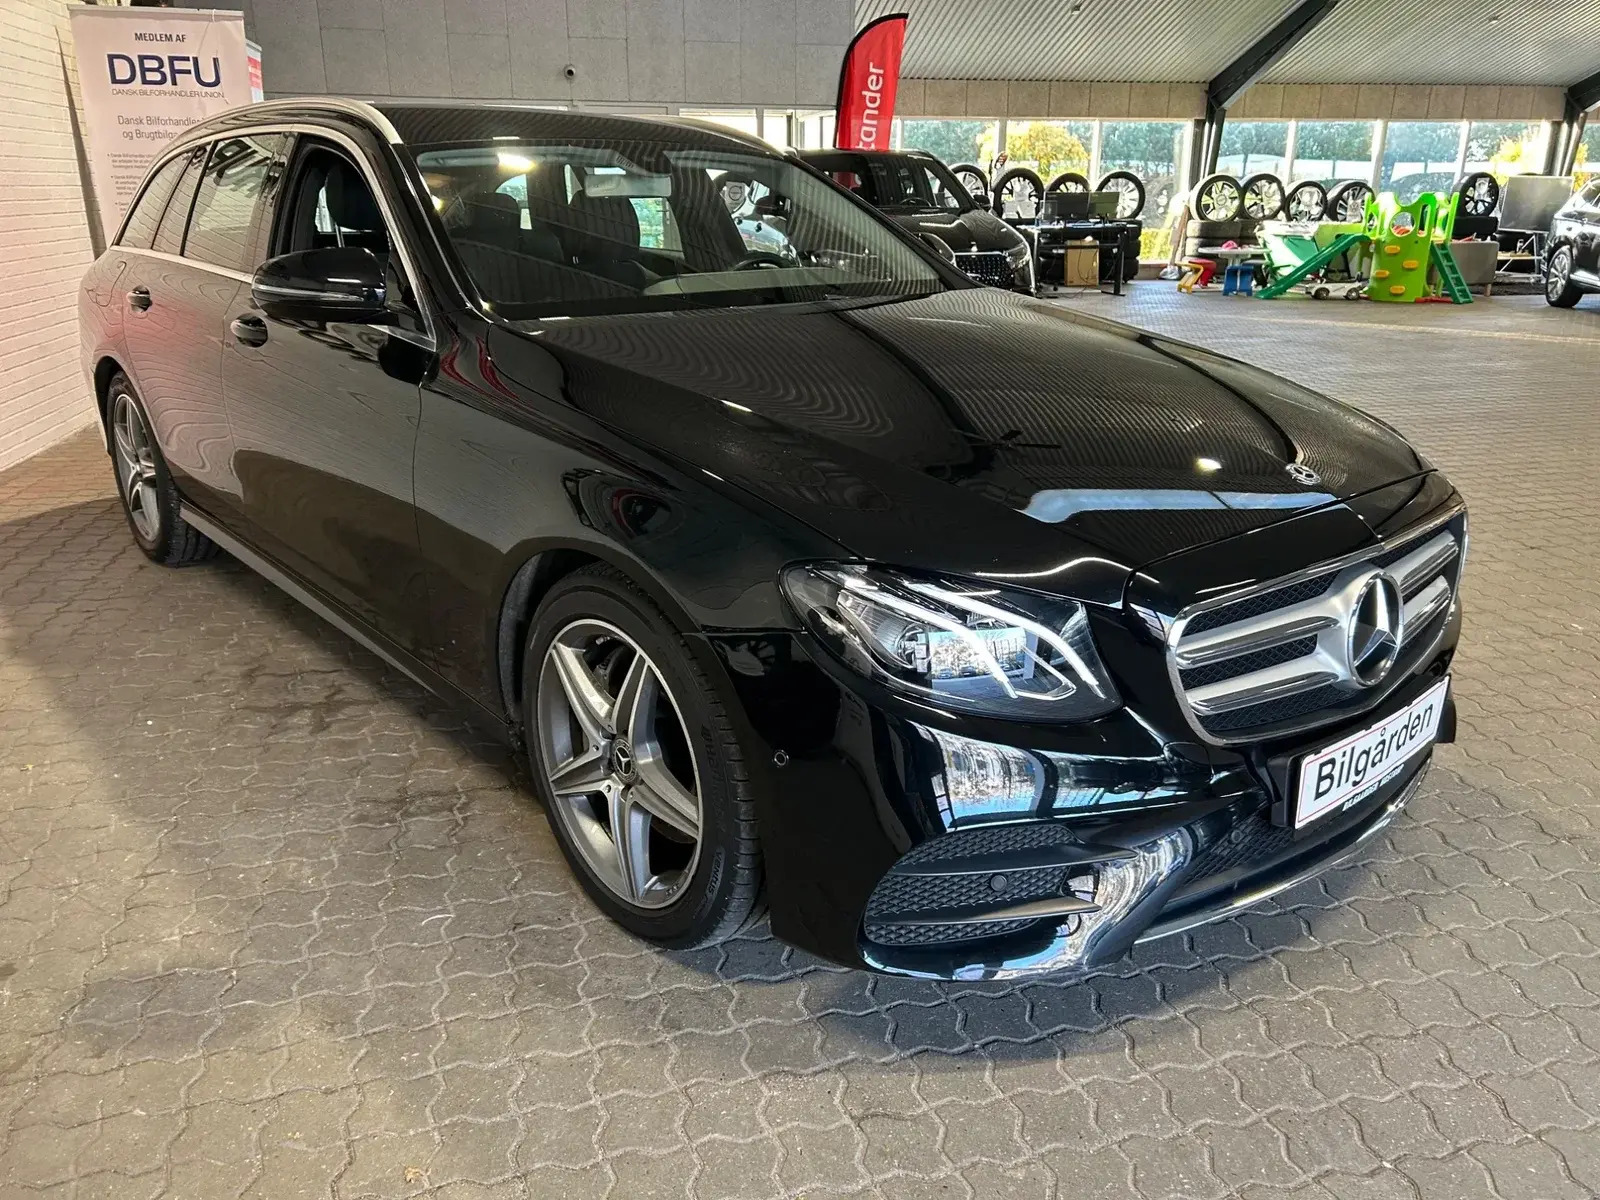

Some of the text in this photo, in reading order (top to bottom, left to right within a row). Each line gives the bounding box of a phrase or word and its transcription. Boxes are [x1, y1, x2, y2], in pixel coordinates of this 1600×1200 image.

[134, 32, 187, 43] MEDLEM AF
[106, 53, 221, 88] DBFU
[112, 88, 139, 97] DANSK
[201, 90, 225, 99] UNION
[117, 115, 145, 126] Dansk
[122, 130, 134, 141] og
[1314, 703, 1434, 801] Bilgården
